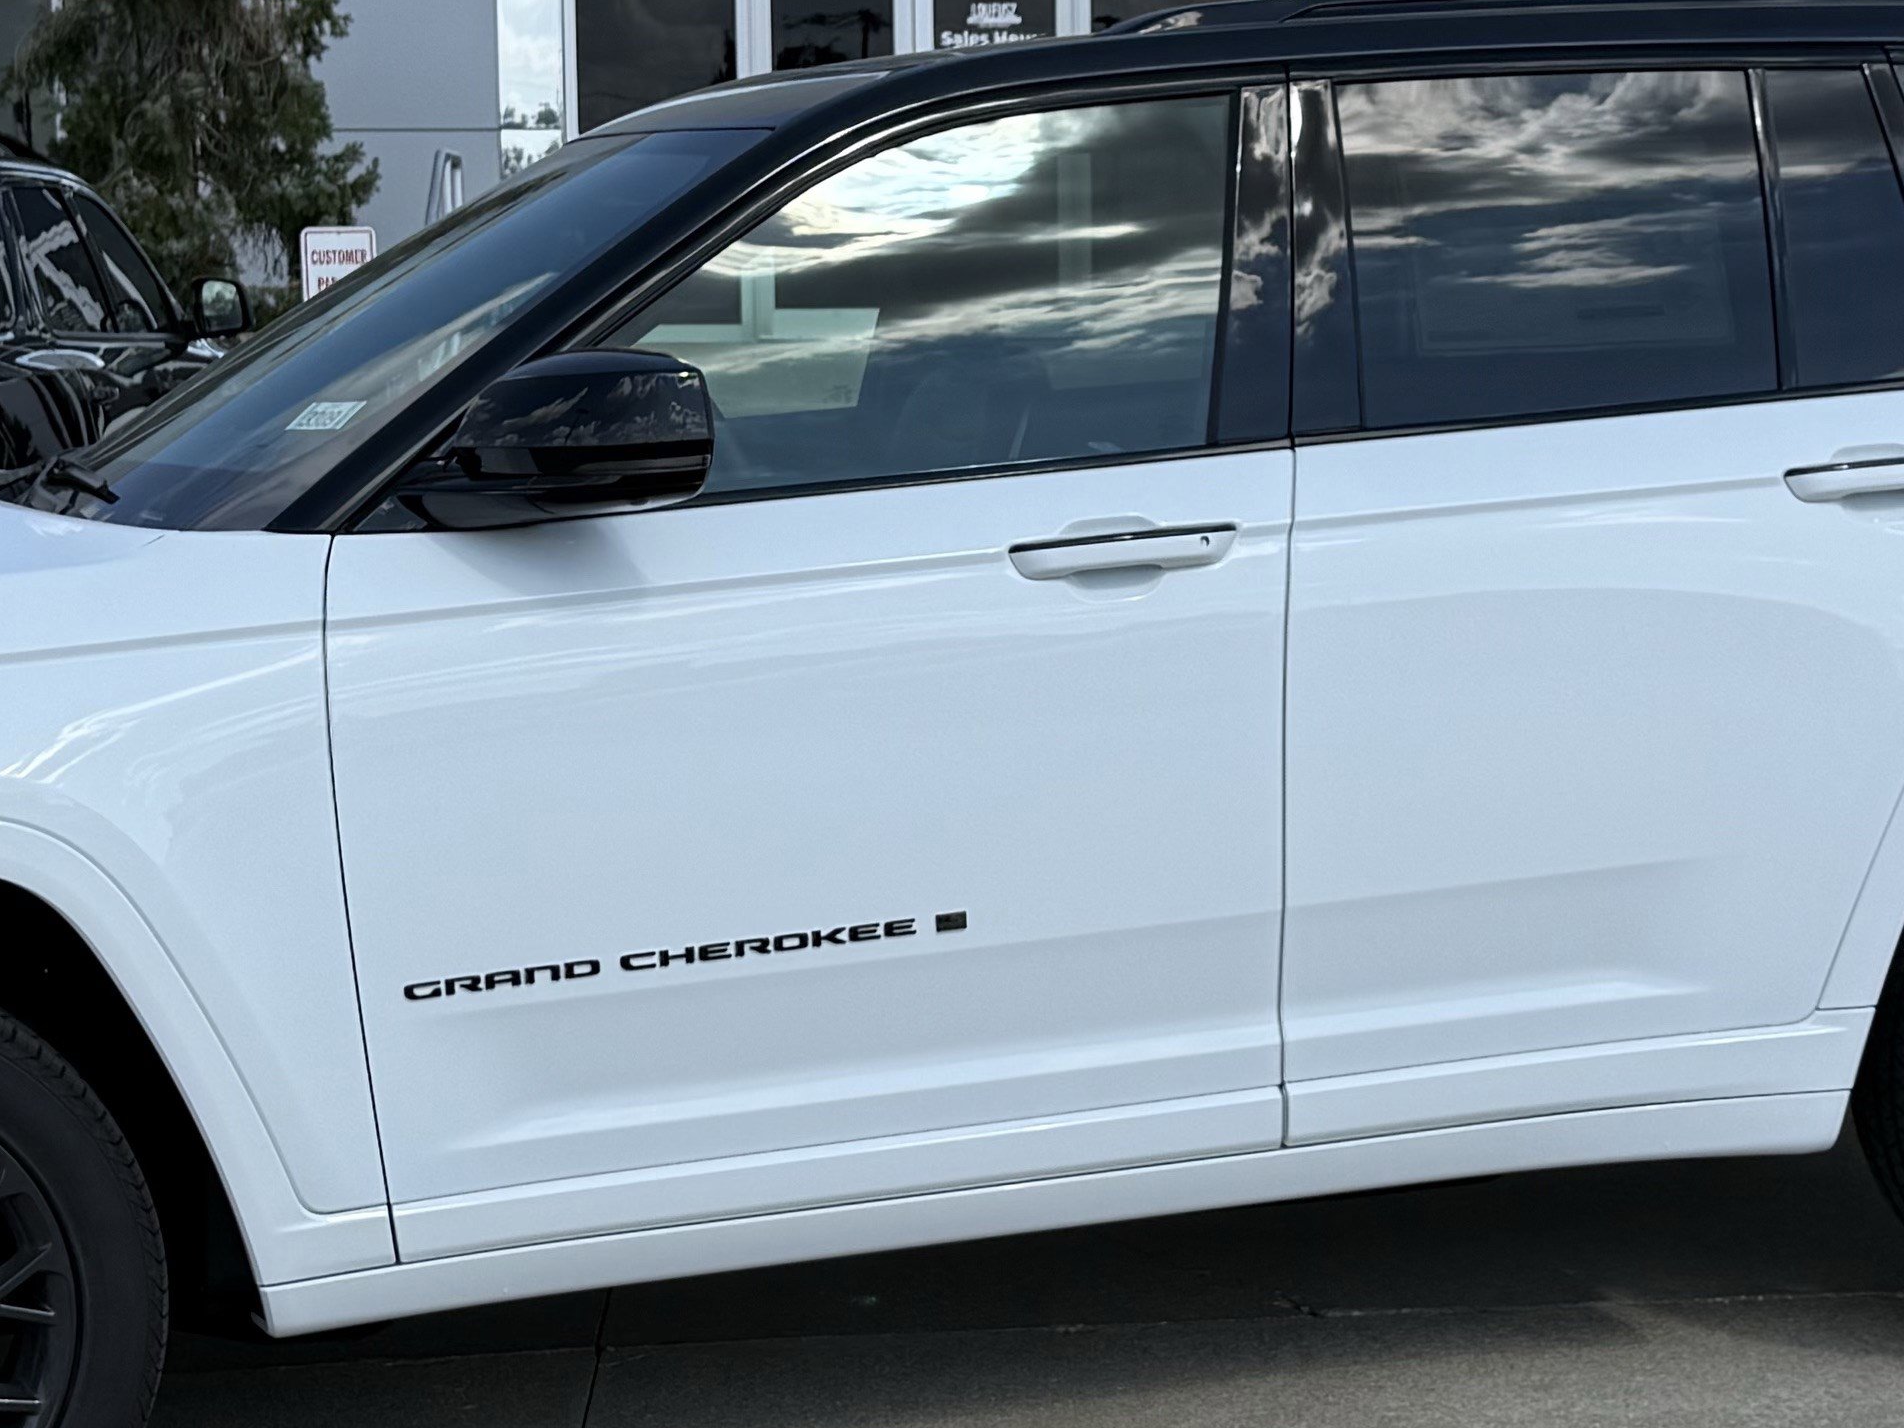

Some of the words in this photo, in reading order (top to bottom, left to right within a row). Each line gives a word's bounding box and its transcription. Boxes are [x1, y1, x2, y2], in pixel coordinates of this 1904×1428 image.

[311, 249, 367, 265] CUSTOMER
[403, 957, 601, 1002] GRAND
[619, 917, 918, 972] CHEROKEE
